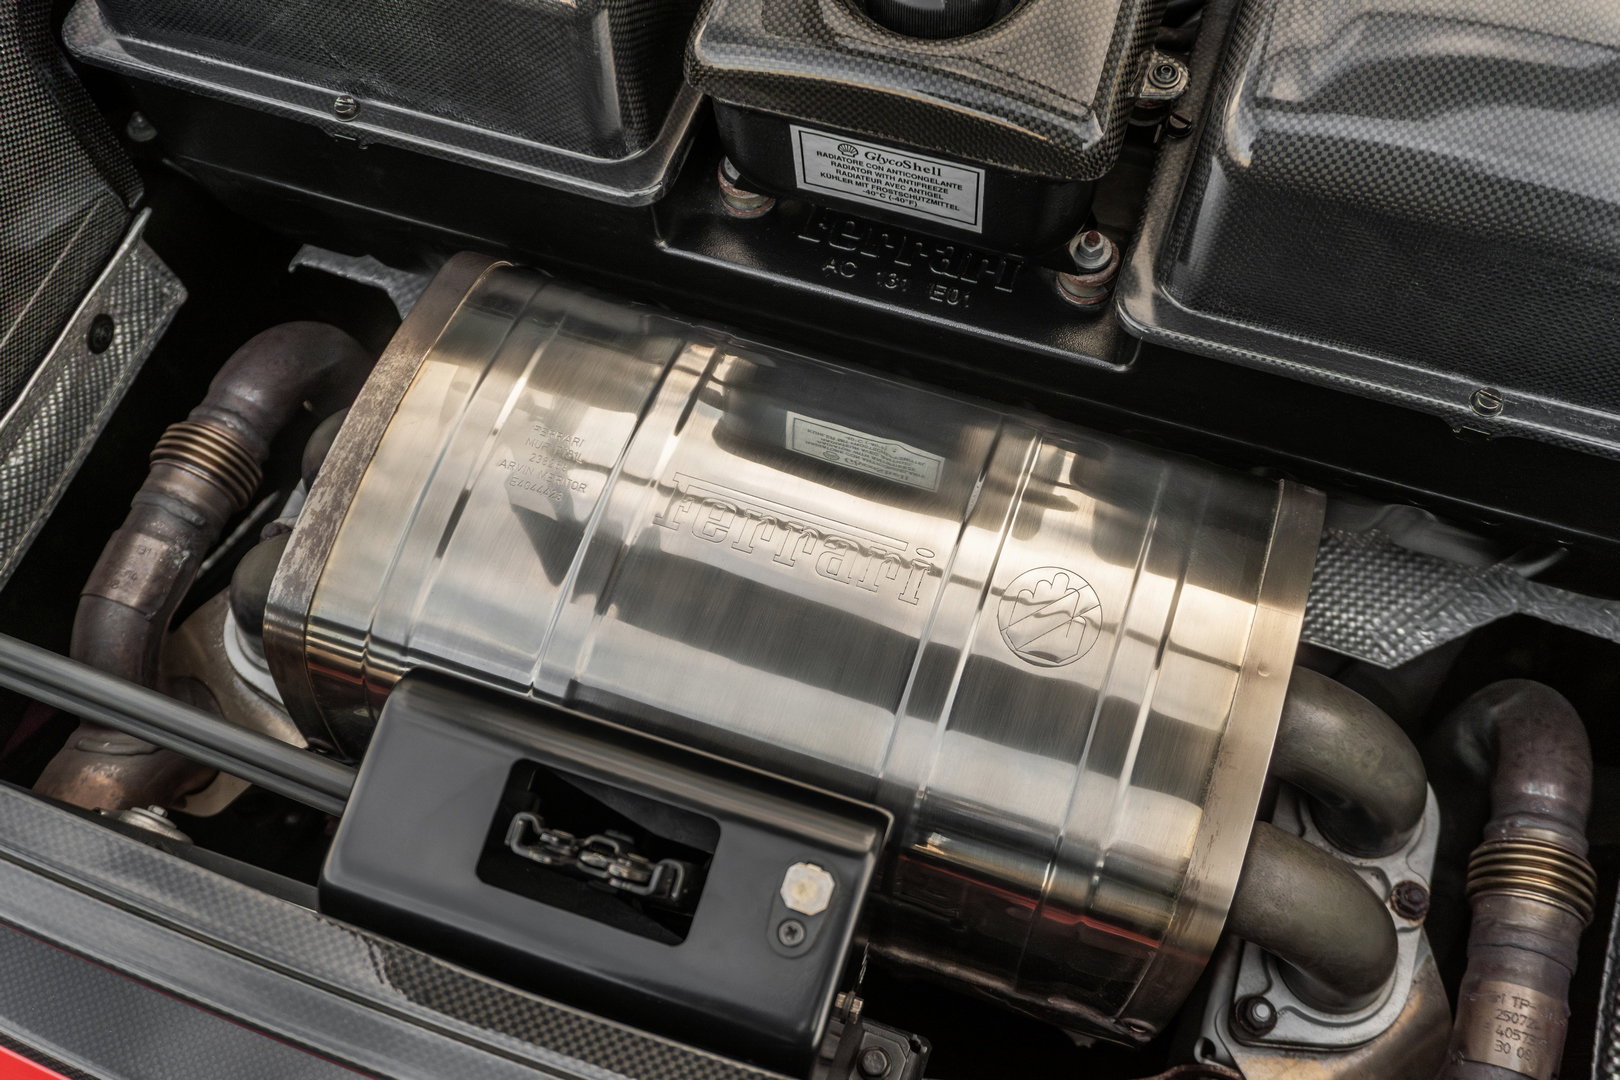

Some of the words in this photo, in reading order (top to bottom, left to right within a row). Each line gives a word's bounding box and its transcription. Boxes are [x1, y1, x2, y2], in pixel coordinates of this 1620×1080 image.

[816, 150, 864, 167] RADIATORE
[866, 163, 884, 171] CON
[886, 167, 963, 191] ANTICONGELANTE
[831, 160, 873, 176] RADIATOR
[874, 171, 895, 181] WITH
[898, 176, 949, 195] ANTIFREEZE
[864, 151, 942, 177] GlycoShell
[836, 168, 882, 185] RADIATEUR
[884, 181, 906, 191] AVEC
[908, 186, 944, 200] ANTIGEL
[871, 184, 960, 211] FROSTSCHUTZMITTEL
[652, 471, 936, 606] Ferrari
